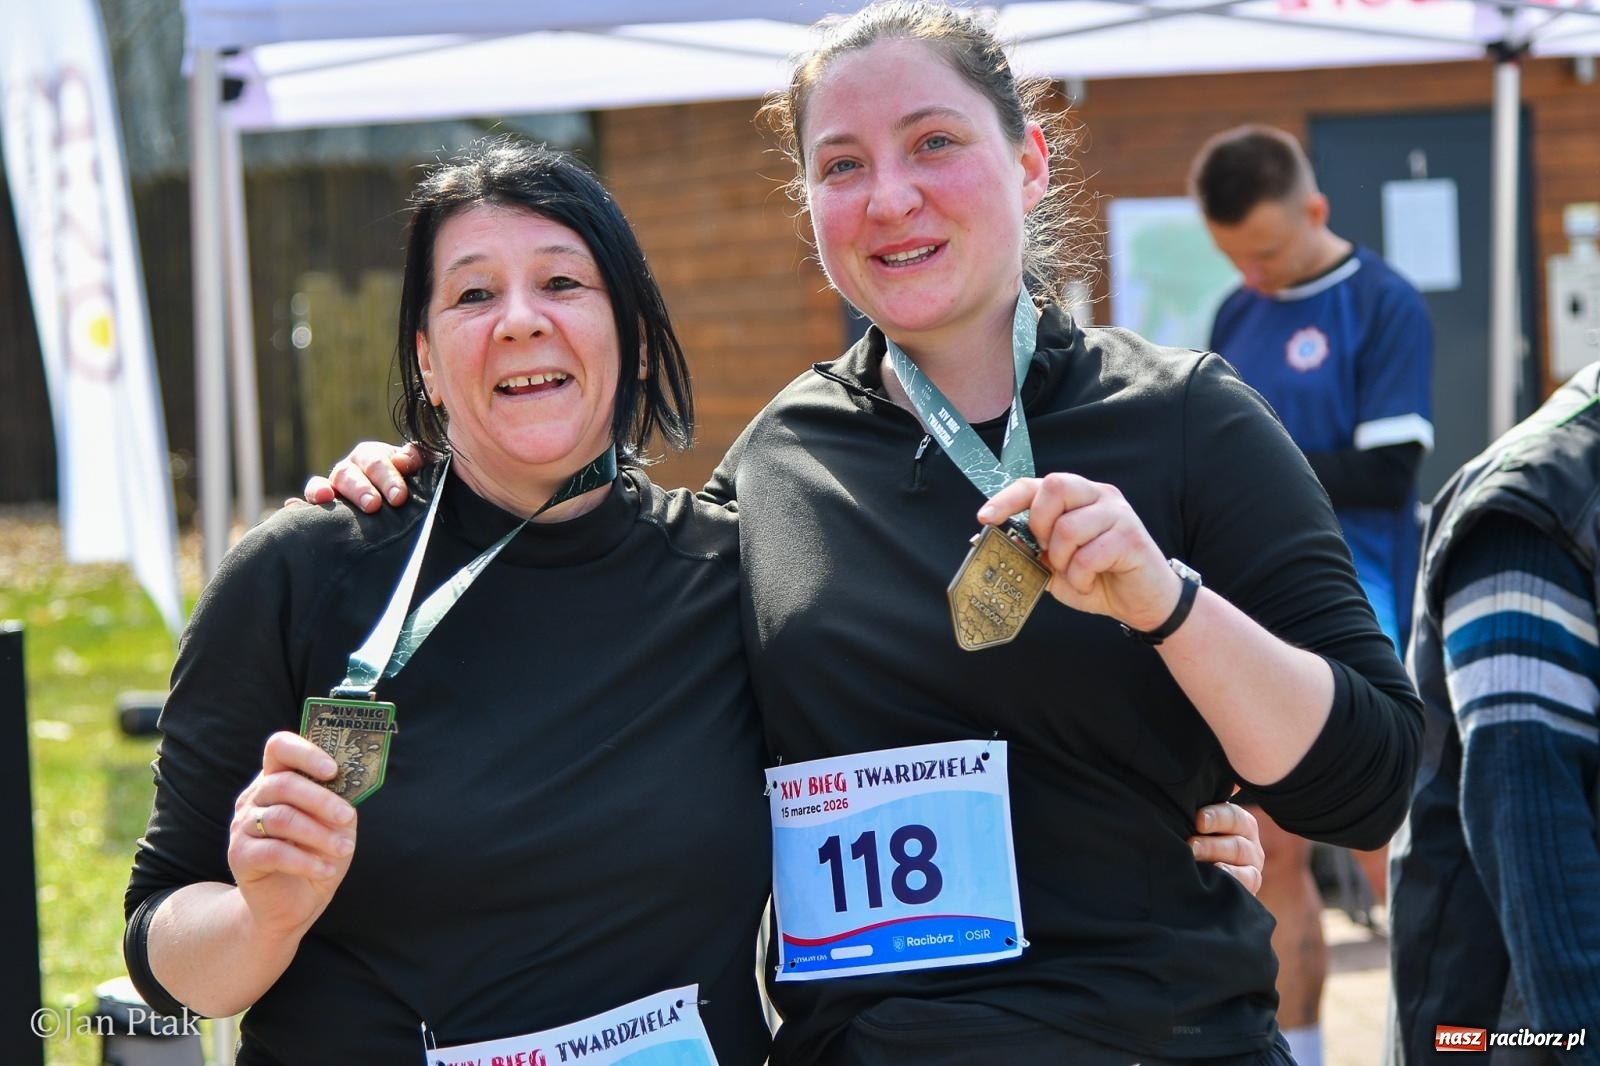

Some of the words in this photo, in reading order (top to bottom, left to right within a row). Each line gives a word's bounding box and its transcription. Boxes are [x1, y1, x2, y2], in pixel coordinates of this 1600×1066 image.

[331, 706, 355, 717] XIV
[356, 708, 384, 719] BIEG
[318, 718, 398, 733] TWARDZIELA
[781, 777, 802, 800] XIV
[808, 772, 847, 796] BIEG
[854, 756, 985, 788] TWARDZIELA
[781, 807, 790, 818] 15
[791, 804, 821, 816] marzec
[823, 798, 849, 812] 2026
[818, 824, 943, 912] 118
[906, 932, 954, 947] Racibórz
[965, 929, 991, 941] OSiR
[555, 1004, 680, 1062] TWARDZIELA
